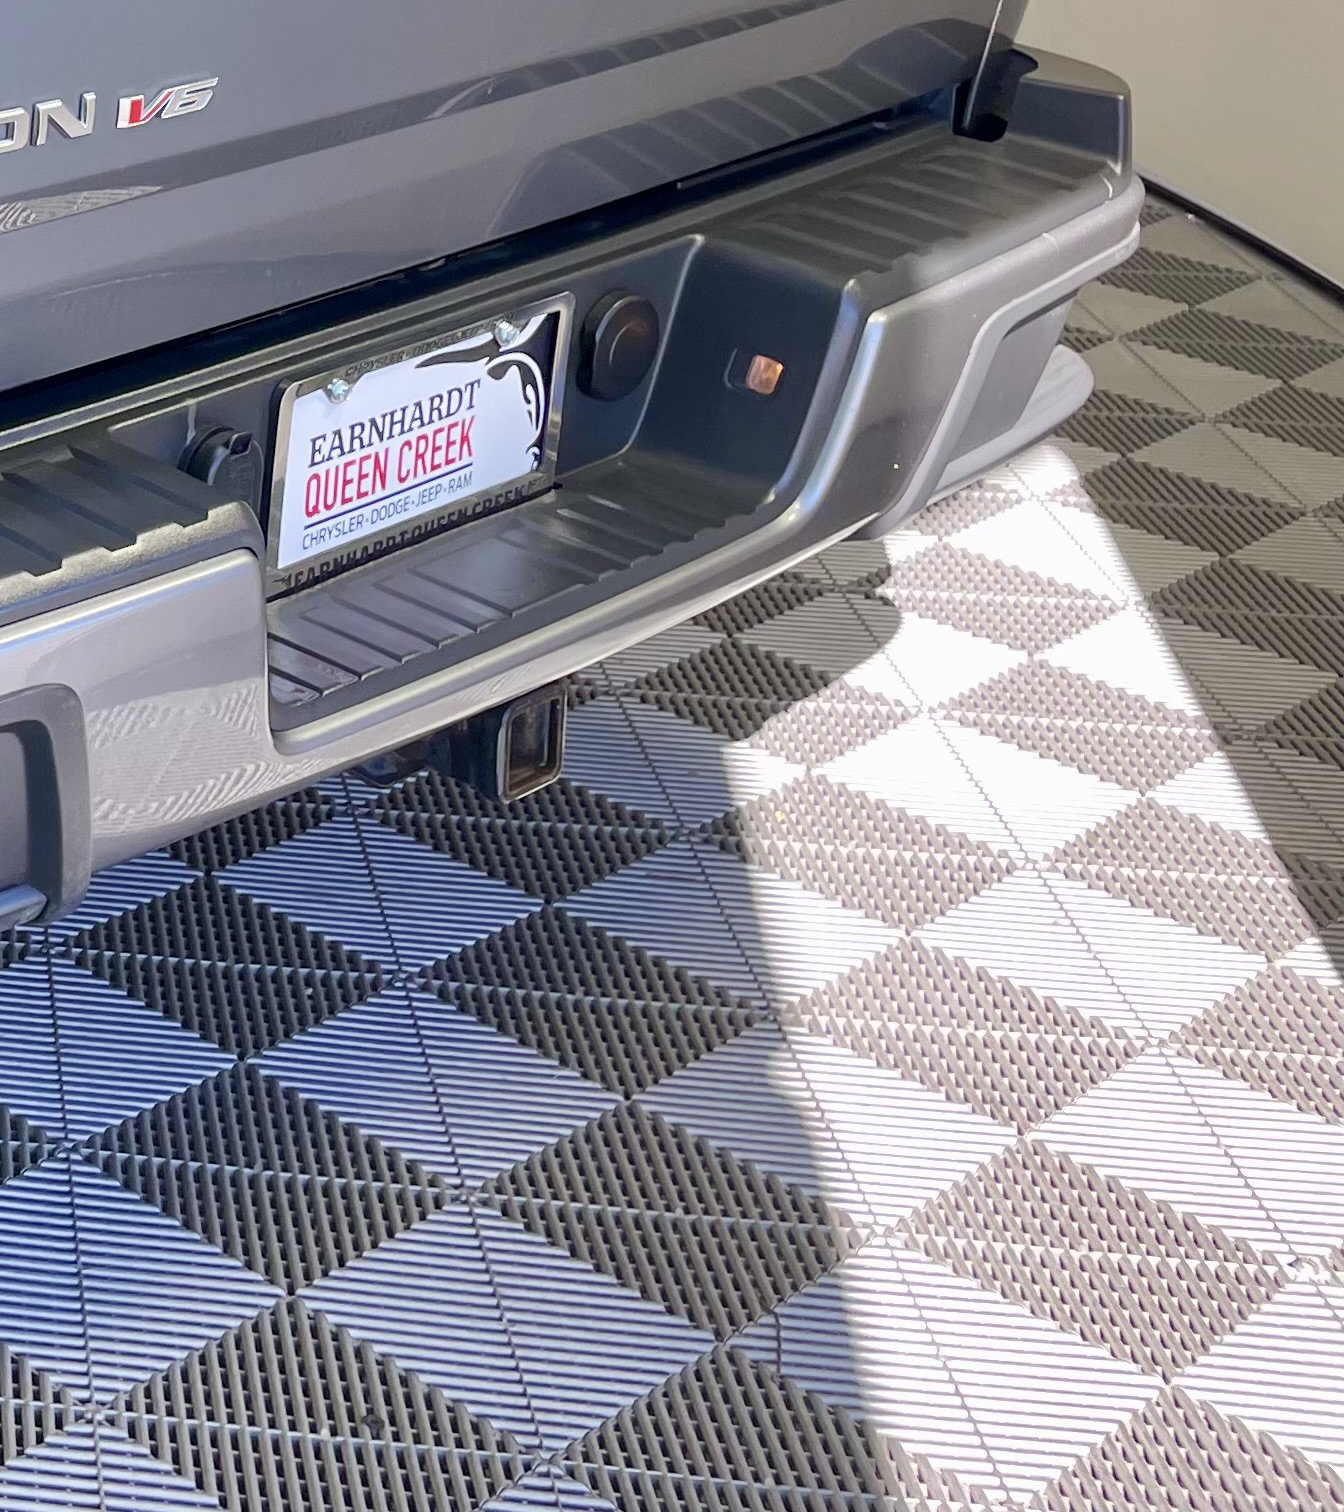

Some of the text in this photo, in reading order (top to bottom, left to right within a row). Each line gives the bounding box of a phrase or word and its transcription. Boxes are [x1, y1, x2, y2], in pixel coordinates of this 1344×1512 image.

[116, 77, 218, 130] V6
[304, 415, 476, 519] QUEEN CREEK
[307, 379, 481, 469] EARNHARDT
